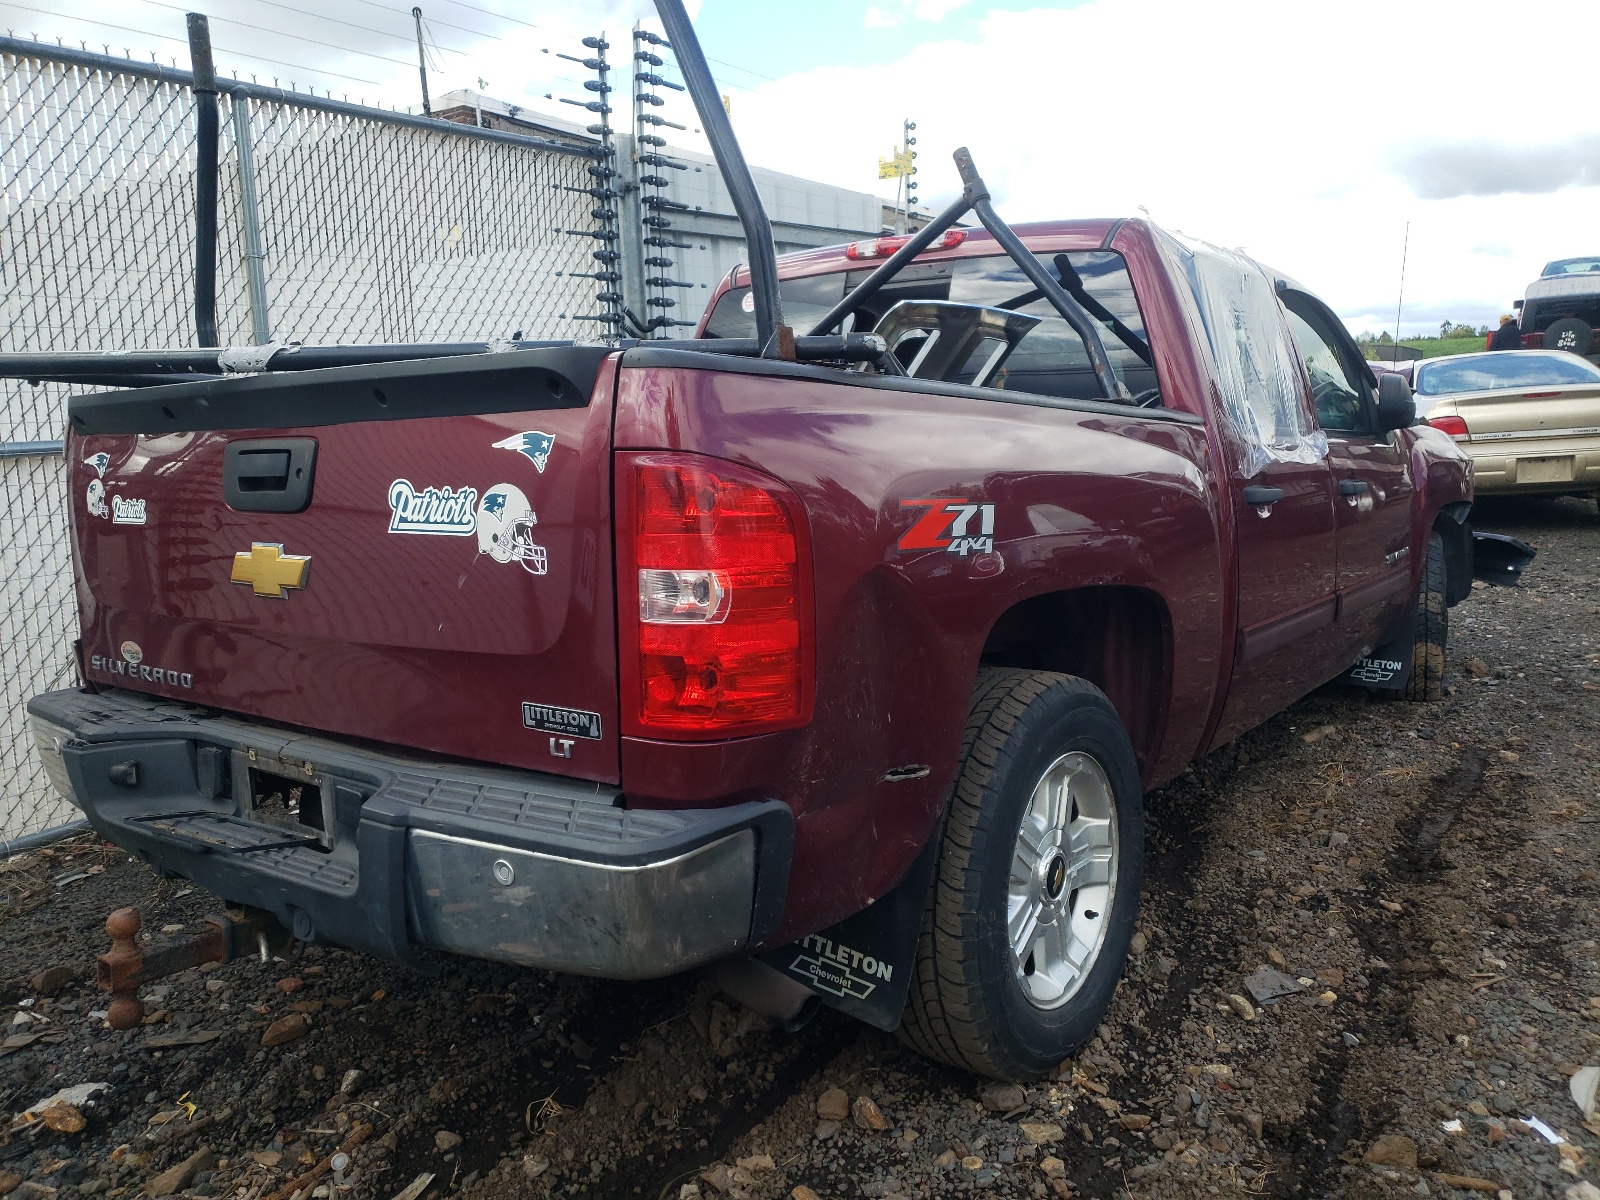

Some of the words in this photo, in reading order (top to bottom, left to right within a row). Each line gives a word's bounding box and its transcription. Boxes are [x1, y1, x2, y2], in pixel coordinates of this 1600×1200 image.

[389, 480, 476, 535] Patriots
[898, 498, 995, 550] Z71
[91, 655, 193, 690] SILVERADO
[524, 705, 590, 728] LITTLETON
[549, 737, 575, 759] LT
[795, 933, 893, 982] TTLETON
[809, 964, 852, 989] Chevrolet
